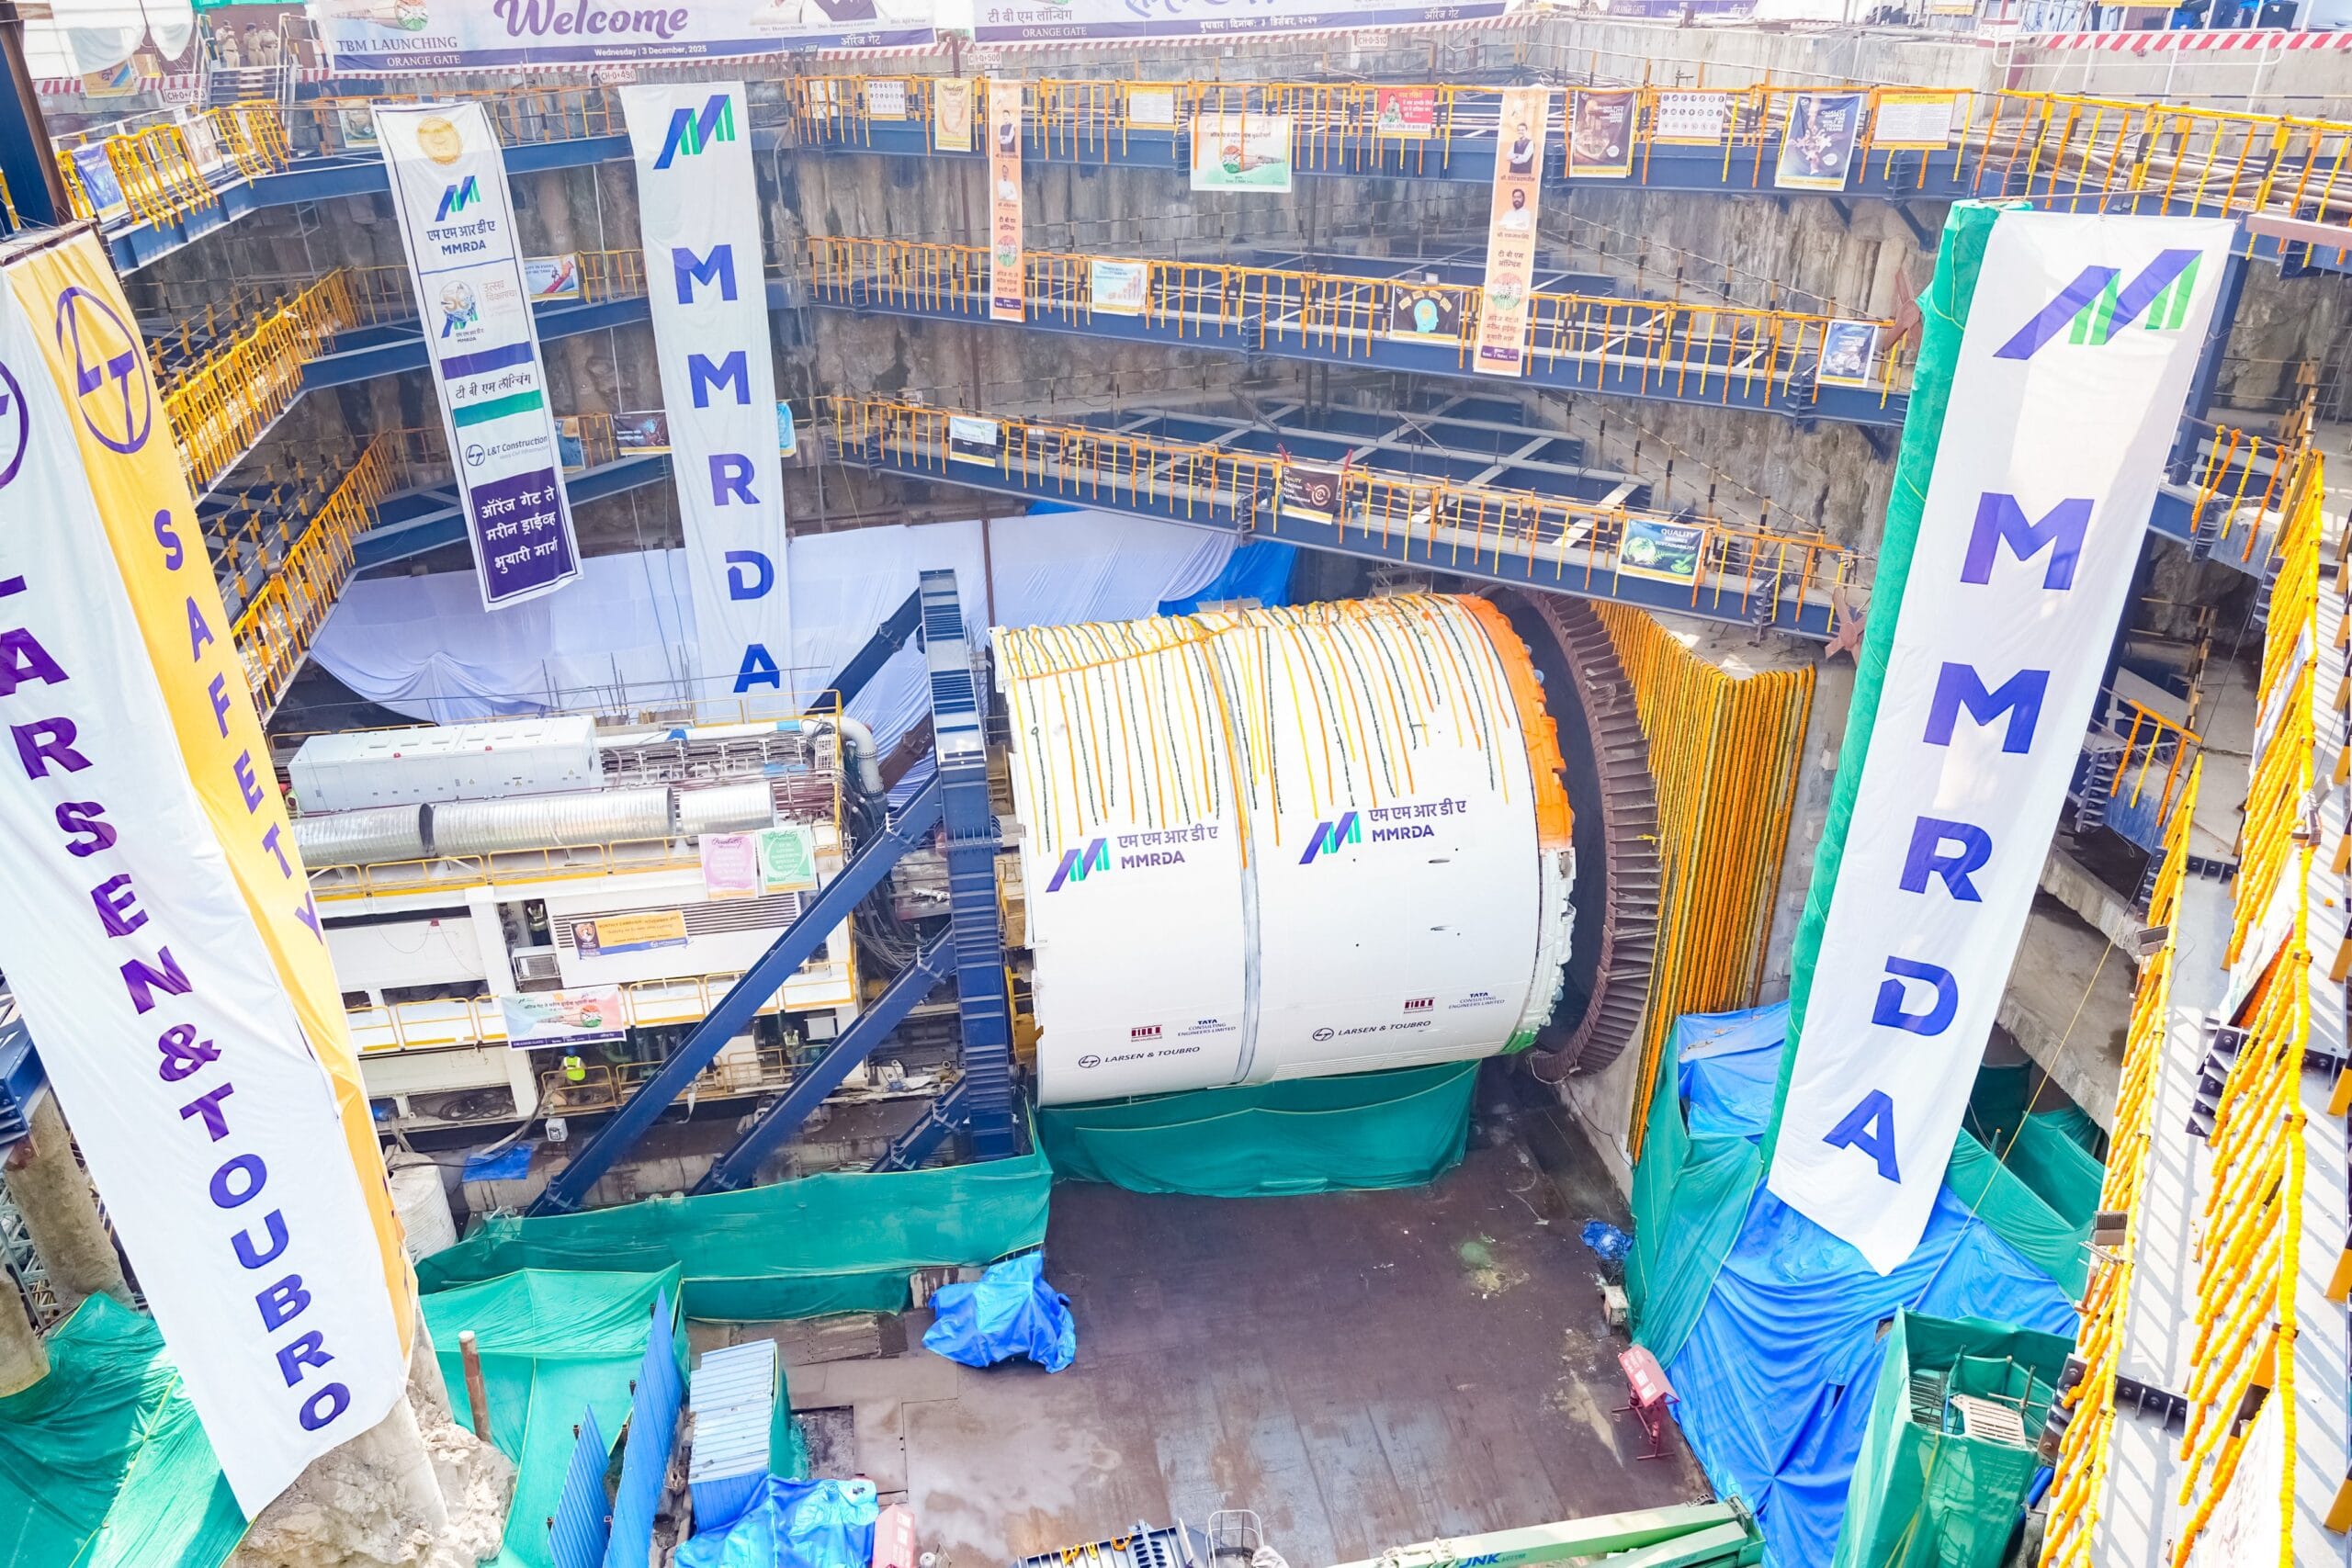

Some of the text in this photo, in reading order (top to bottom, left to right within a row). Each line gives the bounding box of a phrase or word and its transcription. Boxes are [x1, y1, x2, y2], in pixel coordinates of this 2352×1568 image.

[493, 0, 688, 39] Welcome
[988, 9, 999, 23] टी
[1002, 9, 1015, 23] बी
[1017, 11, 1032, 24] एम
[1448, 9, 1460, 18] गेट
[1023, 27, 1087, 37] ORANGE GATE
[1200, 21, 1225, 33] बुधवार
[336, 37, 458, 52] TBM LAUNCHING
[866, 35, 881, 46] गेट
[594, 45, 707, 58] Wednesday 3 December, 2025
[387, 55, 461, 67] ORANGE GATE
[426, 230, 440, 242] एम
[442, 228, 458, 239] एम
[458, 226, 475, 238] आर
[487, 221, 496, 231] ए
[441, 240, 487, 256] MMRDA
[456, 372, 531, 399] टी बी एम लॉन्चिंग
[487, 446, 502, 457] L&T
[502, 435, 548, 452] Construction
[672, 244, 780, 693] MMRDA
[481, 485, 555, 518] ऑरेंज गेट ते
[486, 512, 556, 541] मरीन ड्राईव्ह
[1661, 528, 1694, 537] QUALITY
[494, 536, 558, 574] भुयारी मार्ग
[154, 510, 322, 946] SAFETY
[1368, 797, 1466, 822] एम एम आर डी ए
[1117, 823, 1218, 849] एम एम आर डी ए
[1372, 825, 1434, 842] MMRDA
[1824, 491, 2095, 1185] MMRDA
[1121, 851, 1185, 869] MMRDA
[0, 575, 351, 1431] ARSEN & TOUBRO
[1448, 1001, 1480, 1010] ENGINEERS
[1459, 996, 1497, 1004] CONSULTING
[1188, 1022, 1227, 1031] CONSULTING
[1338, 1026, 1376, 1036] LARSEN
[1390, 1021, 1431, 1030] TOUBRO
[1104, 1053, 1144, 1063] LARSEN
[1158, 1046, 1201, 1057] TOUBRO
